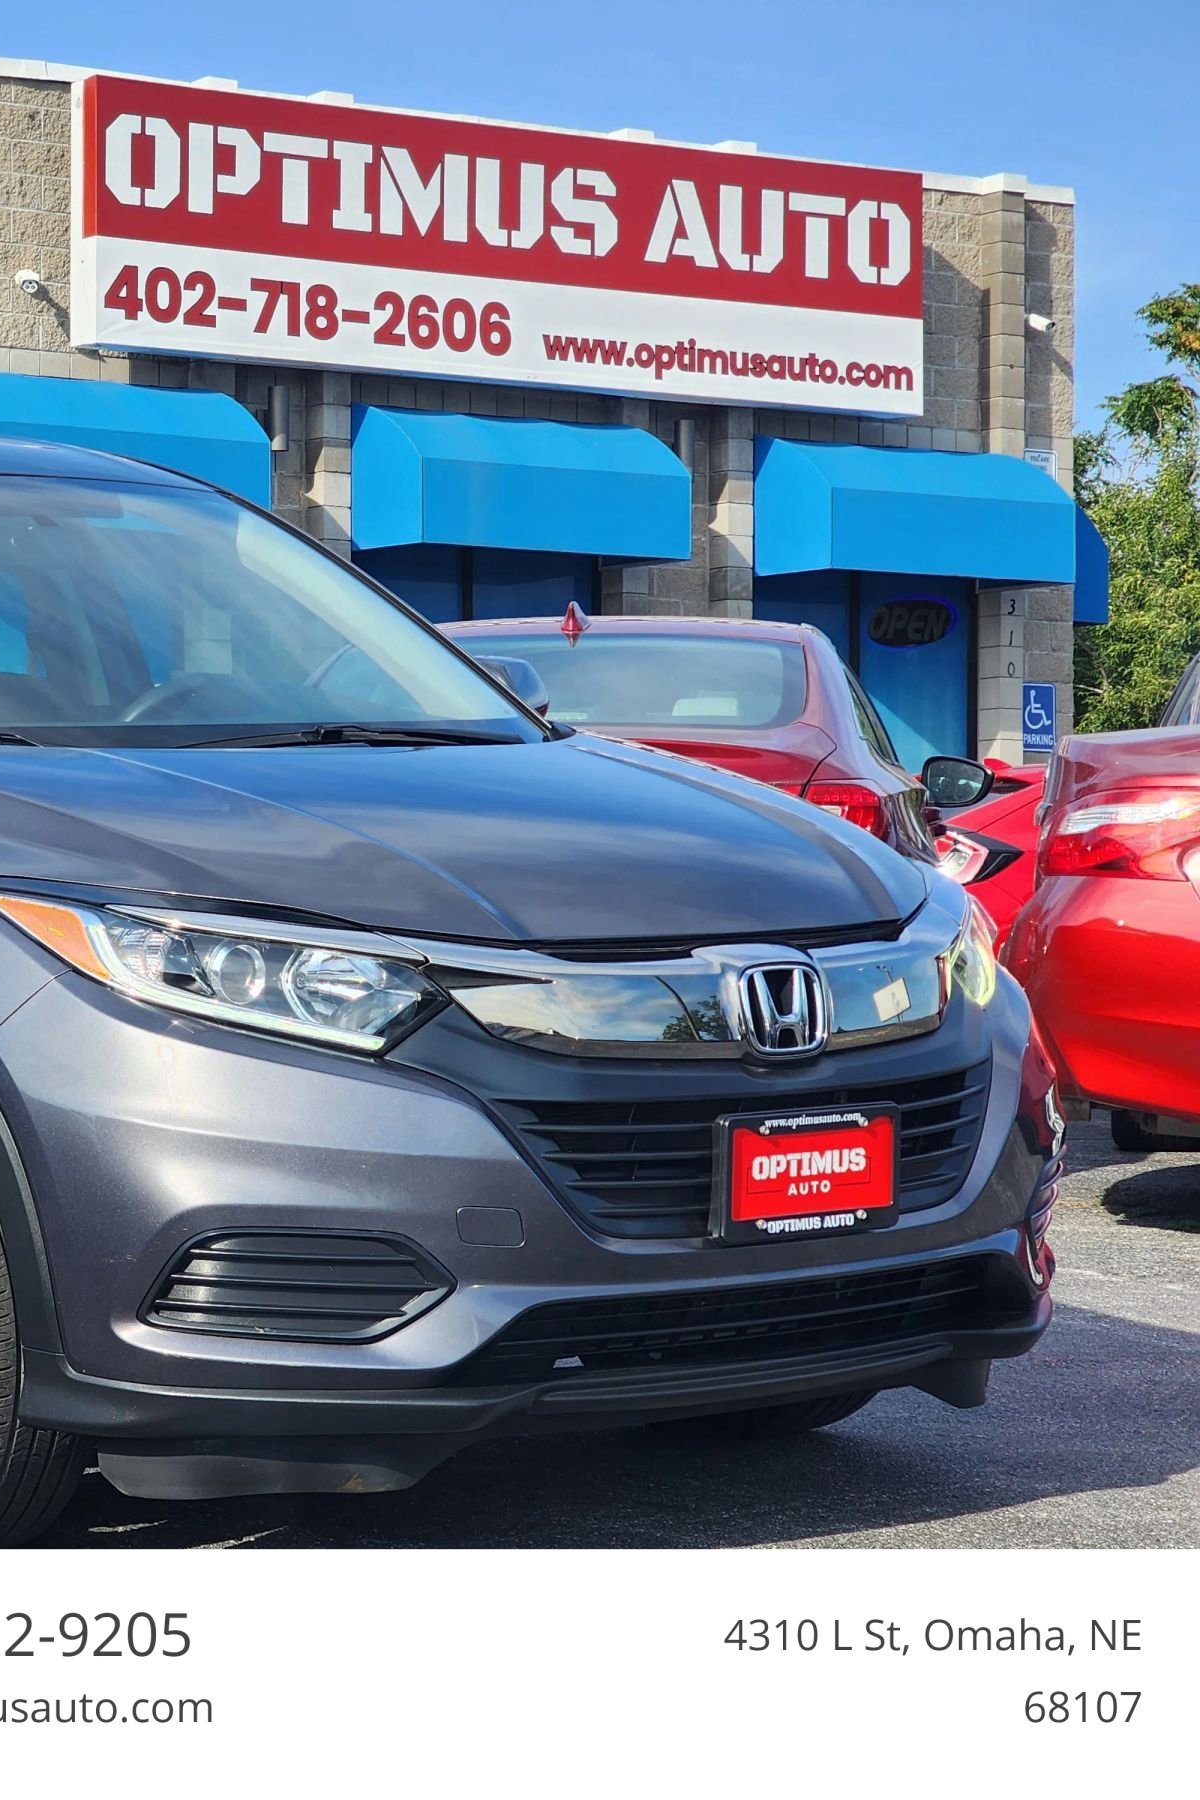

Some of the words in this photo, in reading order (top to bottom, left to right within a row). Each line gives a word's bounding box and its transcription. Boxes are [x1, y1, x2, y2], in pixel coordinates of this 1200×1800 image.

[104, 112, 618, 258] OPTIMUS
[643, 179, 912, 288] AUTO
[104, 264, 513, 358] 402-718-2606
[542, 330, 914, 392] www.optimusauto.com
[869, 606, 947, 641] OPEN
[1023, 732, 1055, 746] PARKING
[764, 1112, 862, 1131] www.optimusauto.com
[751, 1147, 867, 1181] OPTIMUS
[787, 1179, 832, 1197] AUTO
[766, 1216, 822, 1234] OPTIMUS
[823, 1213, 855, 1229] AUTO
